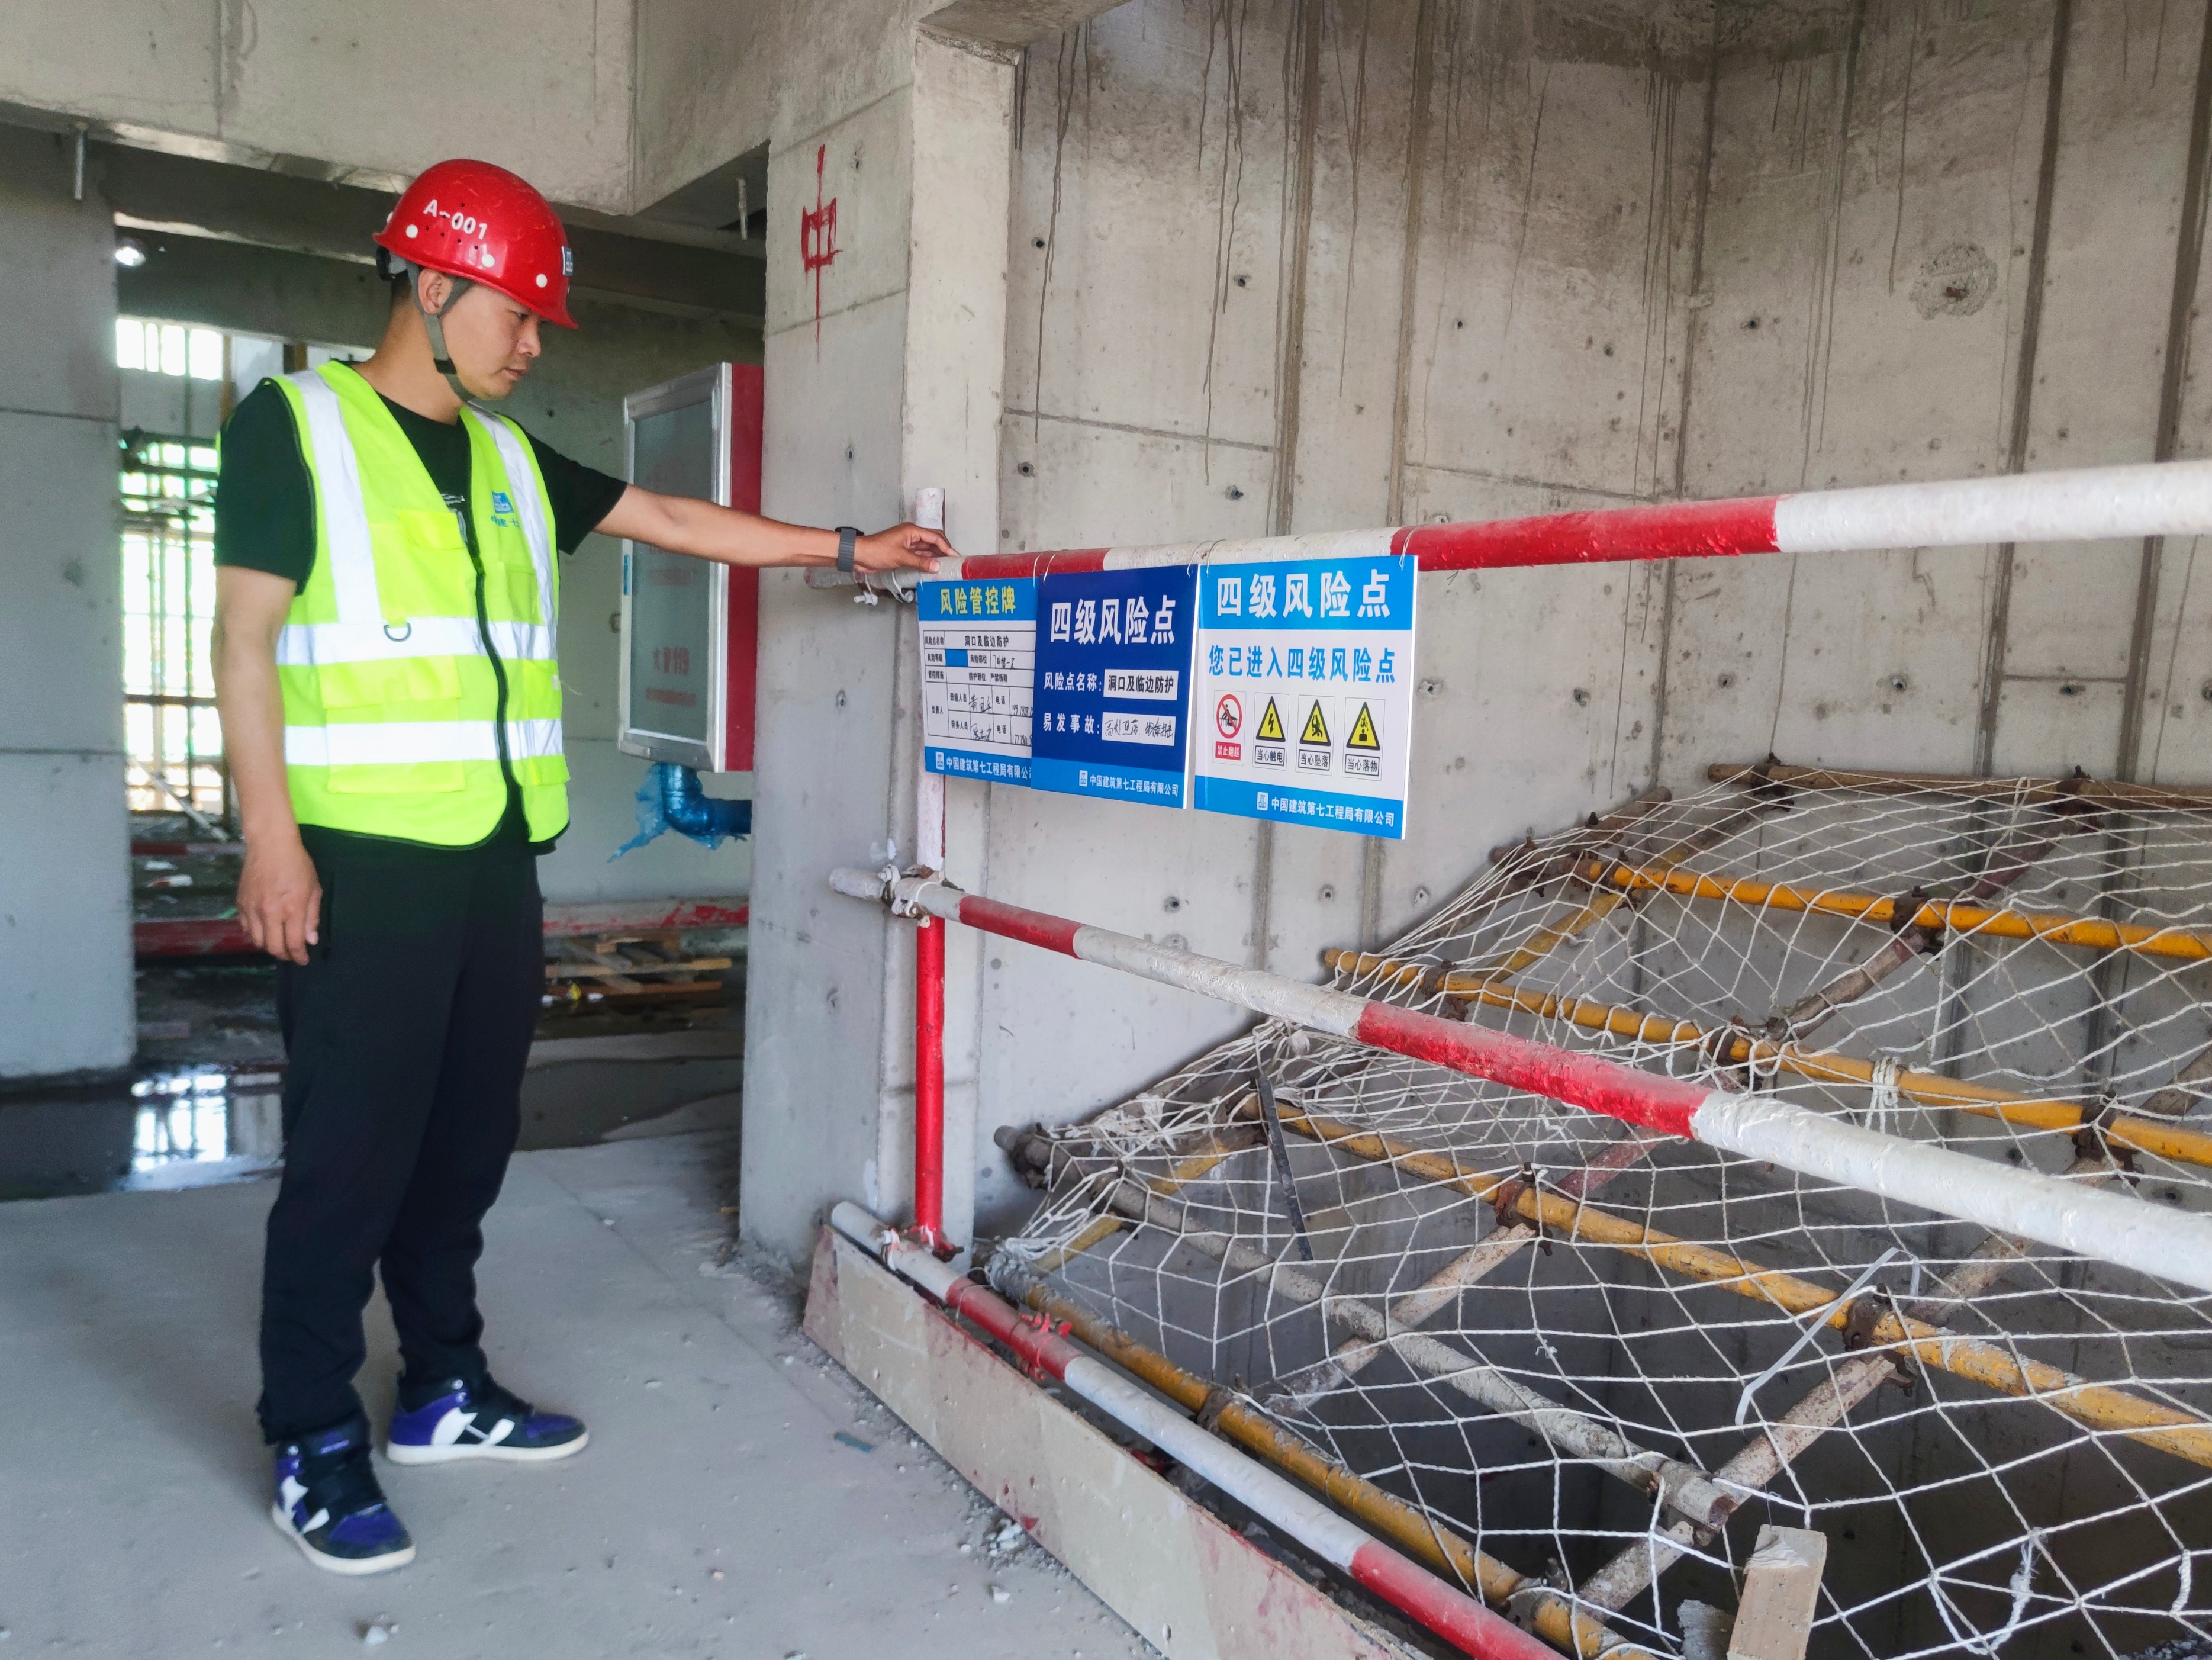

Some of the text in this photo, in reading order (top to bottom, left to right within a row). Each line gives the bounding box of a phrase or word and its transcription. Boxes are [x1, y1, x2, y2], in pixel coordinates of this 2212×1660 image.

[423, 199, 488, 240] A-001
[941, 585, 1016, 615] 风险管控牌
[1217, 569, 1390, 619] 四级风险点
[1051, 594, 1176, 645] 四级风险点
[965, 635, 1009, 648] 洞口及临边防护
[970, 655, 987, 664] 风险部位
[1209, 645, 1395, 683] 您已进入四级风险点
[1107, 674, 1174, 694] 洞口及临边防护
[1217, 744, 1240, 758] 禁止翻越
[1257, 748, 1283, 763] 当心触电
[1300, 751, 1329, 768] 当心坠落
[1347, 755, 1378, 773] 当心落物
[1090, 774, 1179, 797] 中国建筑第七工程局有限公司
[1271, 796, 1395, 827] 中国建筑第七工程局有限公司
